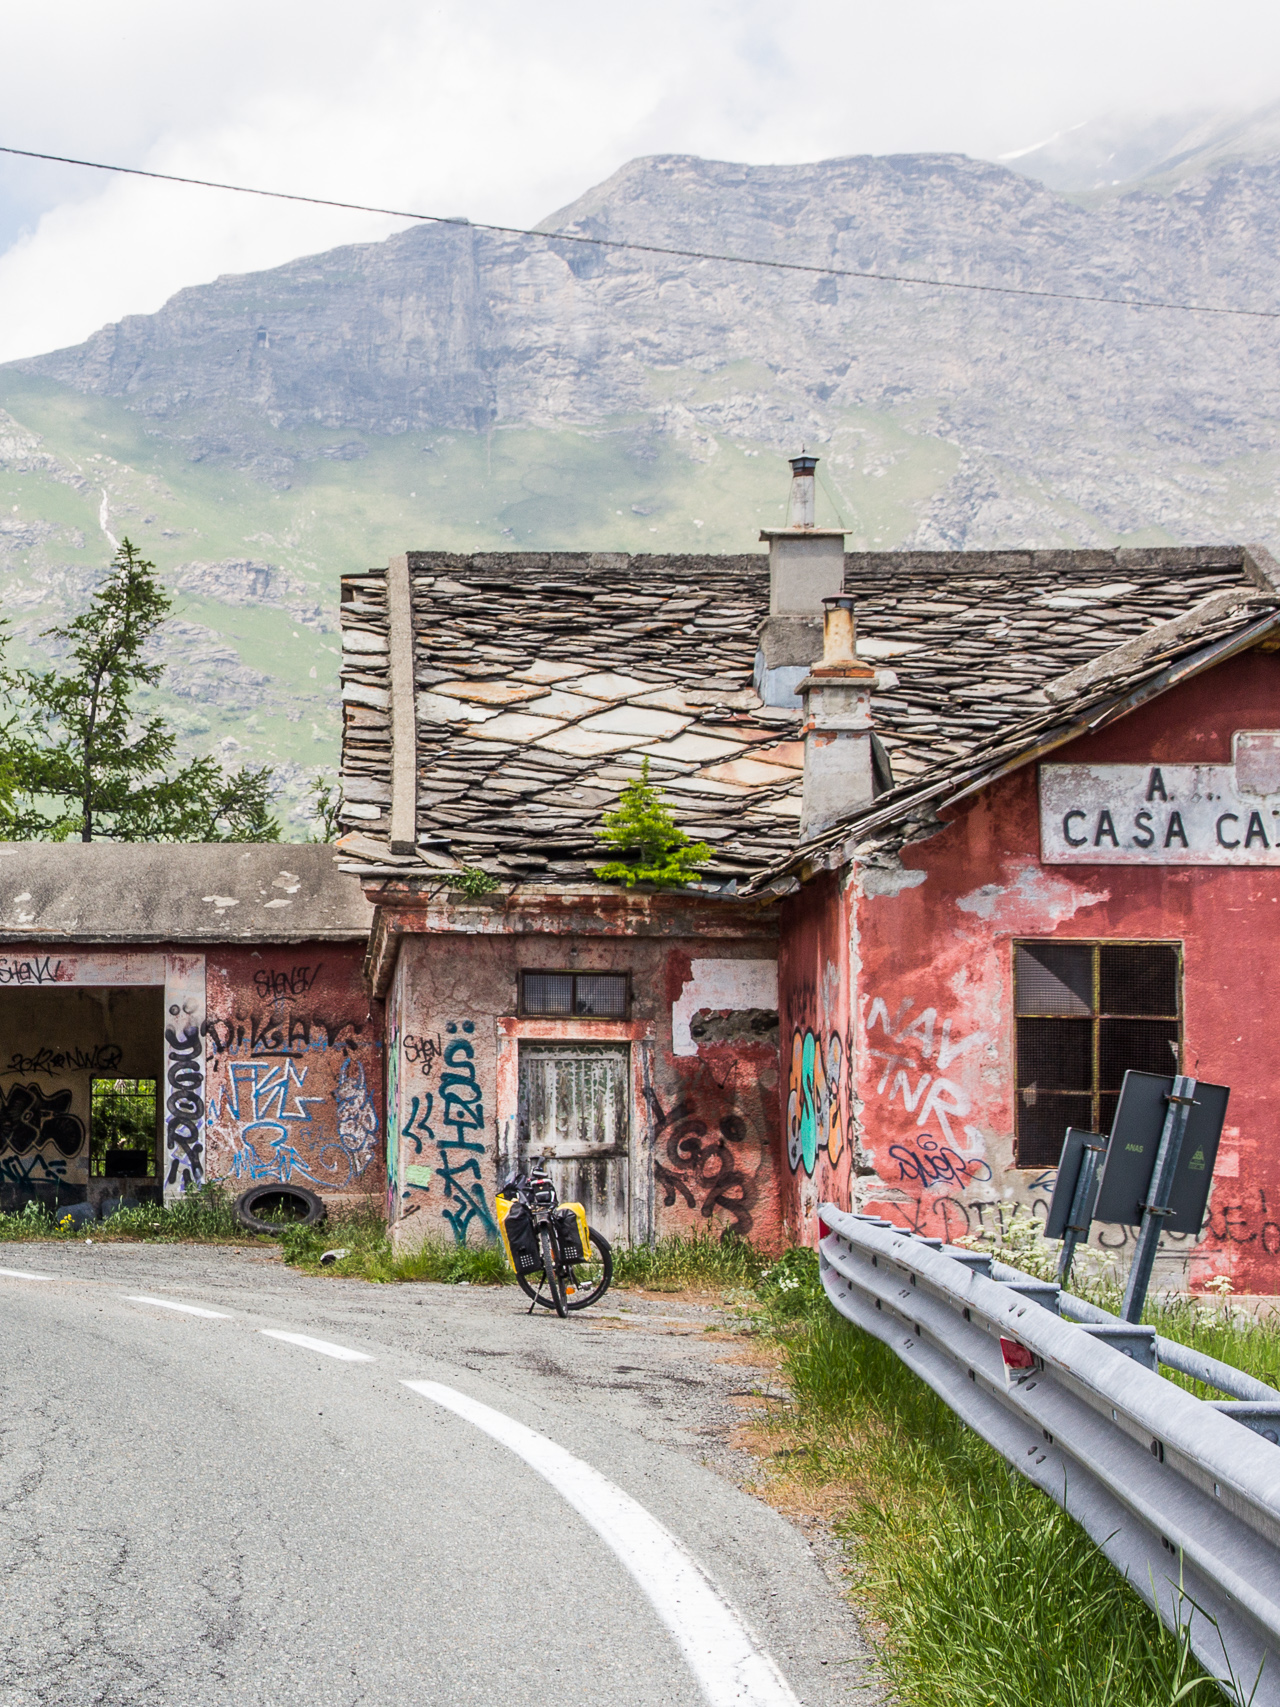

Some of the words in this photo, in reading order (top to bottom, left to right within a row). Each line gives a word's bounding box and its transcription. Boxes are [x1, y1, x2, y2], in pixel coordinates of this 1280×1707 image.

[1062, 809, 1189, 849] CASA
[1215, 811, 1280, 849] CA
[1125, 1143, 1144, 1153] ANAS
